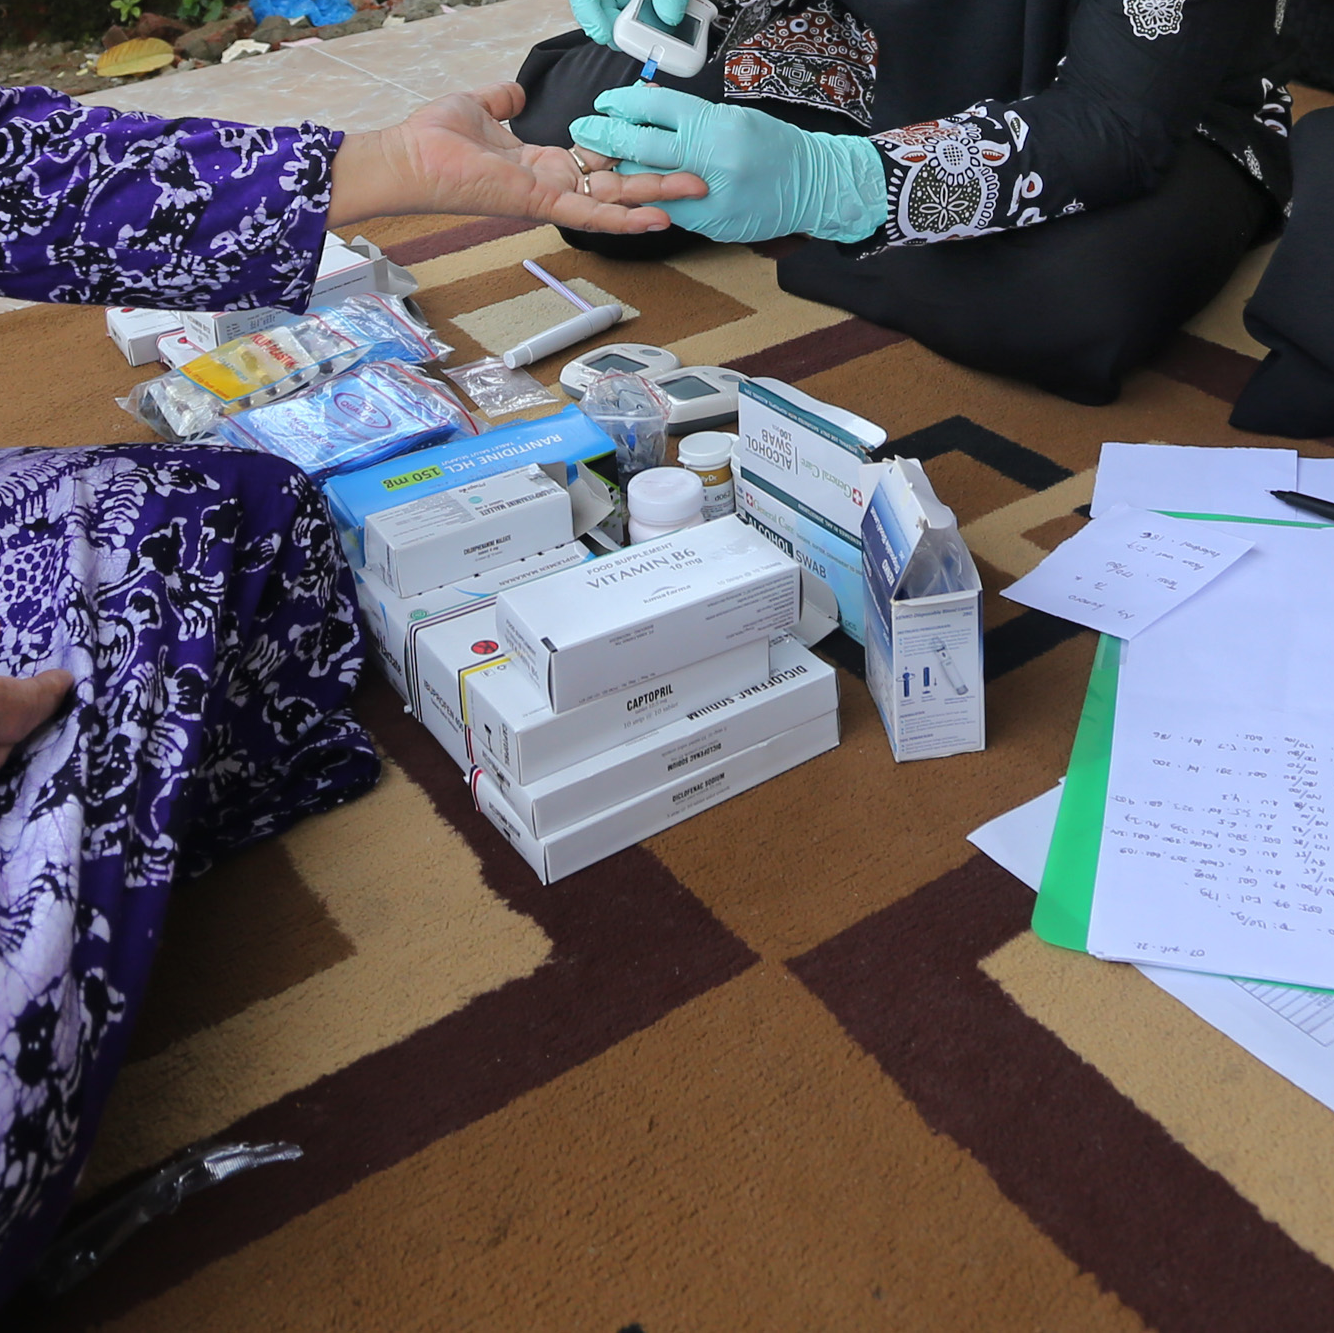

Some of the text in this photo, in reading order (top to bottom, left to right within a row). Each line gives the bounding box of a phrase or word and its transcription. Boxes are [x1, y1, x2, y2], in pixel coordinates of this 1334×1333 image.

[340, 401, 379, 425] QUALITY
[359, 401, 377, 415] TOP
[761, 429, 792, 454] SWAB
[779, 428, 792, 441] 100
[382, 433, 563, 490] RANITIDINE HCL 150 mg
[745, 435, 792, 471] ALCOHOL
[801, 457, 821, 478] Care
[822, 470, 852, 499] General
[479, 501, 505, 516] MALEATE
[587, 542, 673, 576] FOOD SUPPLEMENT
[747, 517, 794, 559] ALCOHOL
[795, 550, 827, 580] SWAB
[585, 547, 697, 590] VITAMIN B6
[669, 557, 703, 571] 10 mg
[498, 568, 539, 586] MAKANAN
[737, 665, 808, 700] DICLOFENAC
[627, 684, 674, 712] CAPTOPRIL
[667, 757, 689, 771] SODIUM
[689, 743, 722, 760] DICLOFENAC
[672, 779, 704, 802] DICLOFENAC
[705, 772, 725, 788] SODIUM
